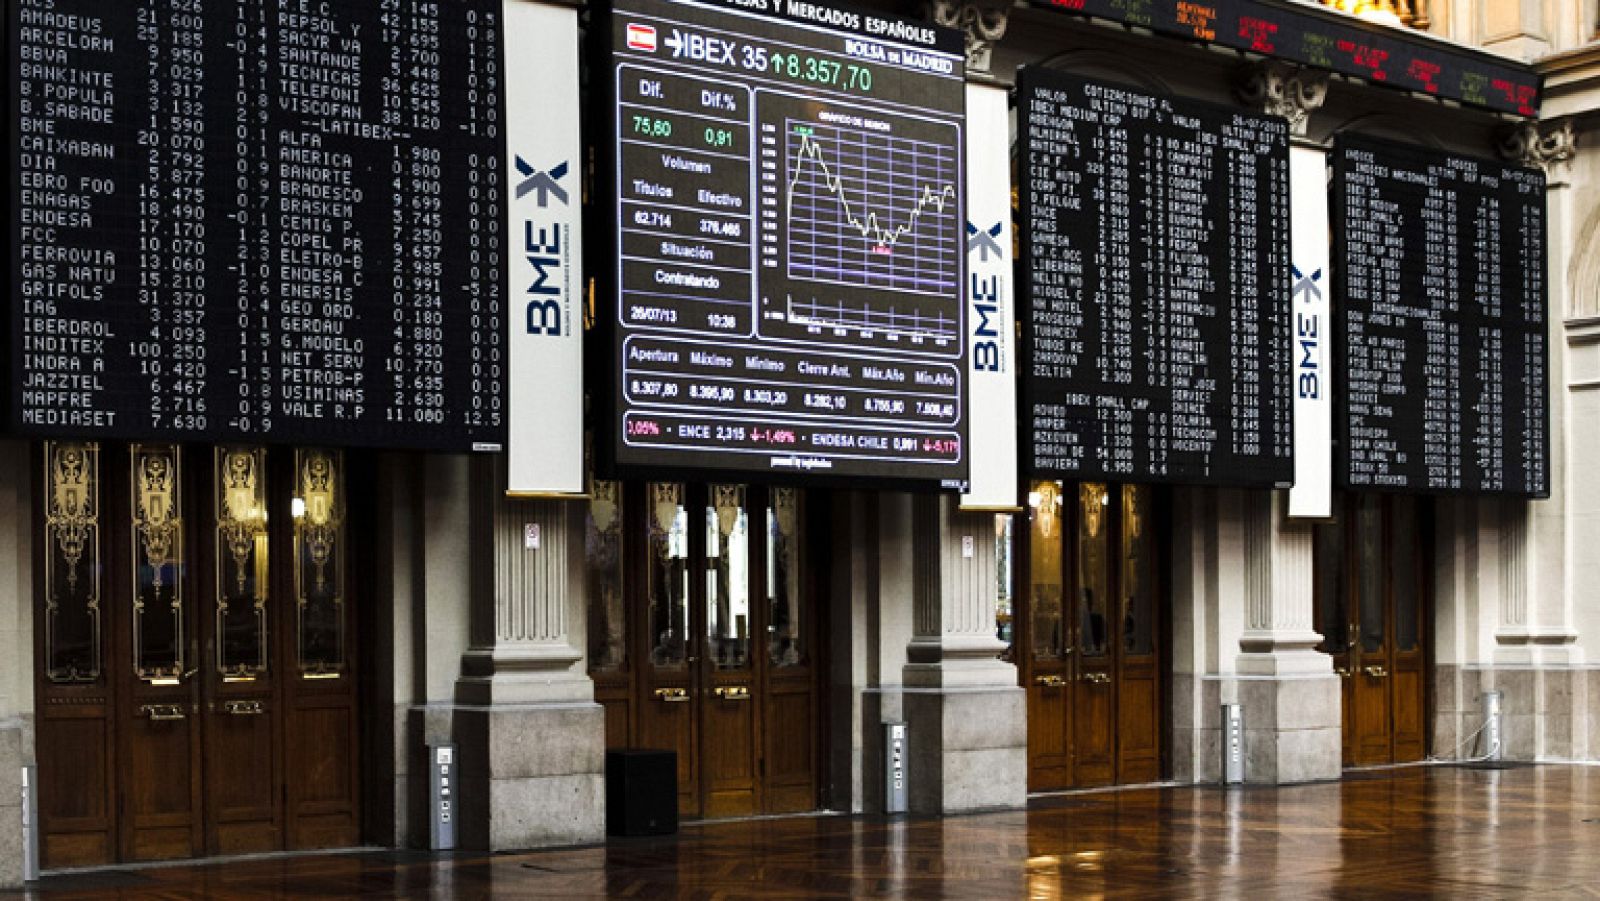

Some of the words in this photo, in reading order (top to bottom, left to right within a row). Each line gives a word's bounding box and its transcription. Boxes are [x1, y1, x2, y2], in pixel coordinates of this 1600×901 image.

[20, 8, 101, 33] AMADEUS
[137, 25, 203, 47] 25.185
[278, 13, 340, 34] REPSOL
[351, 23, 361, 37] Y
[773, 0, 782, 13] Y
[787, 4, 859, 29] MERCADOS
[865, 16, 936, 45] ESPAÑOLES
[20, 27, 113, 52] ARCELORM
[149, 45, 203, 63] 9.950
[278, 29, 330, 49] SACYR
[341, 38, 361, 53] VA
[20, 45, 67, 64] BBVA
[149, 62, 203, 81] 7.029
[279, 45, 361, 71] SANTANDE
[684, 32, 736, 66] IBEX
[742, 47, 767, 72] 35
[786, 55, 872, 91] 8.357,70
[845, 39, 886, 61] BOLSA
[901, 53, 953, 73] MADRID
[20, 62, 113, 88] BANKINTE
[149, 79, 203, 98] 3.317
[279, 62, 361, 87] TECNICAS
[20, 80, 113, 105] B.POPULA
[149, 97, 203, 116] 3.132
[279, 79, 360, 103] TELEFONI
[639, 79, 664, 99] Dif.
[701, 89, 736, 111] Dif.%
[20, 99, 113, 123] B.SABADE
[150, 115, 204, 134] 1.590
[278, 96, 361, 119] VISCOFAN
[20, 117, 55, 134] BME
[137, 131, 204, 151] 20.070
[279, 129, 322, 148] ALFA
[632, 116, 672, 137] 75,60
[704, 128, 733, 147] 0,91
[20, 135, 115, 158] CAIXABAN
[149, 150, 204, 168] 2.792
[280, 147, 352, 168] AMERICA
[661, 154, 712, 174] Volumen
[21, 154, 56, 171] DIA
[149, 167, 204, 185] 5.877
[280, 163, 352, 185] BANORTE
[21, 171, 67, 190] EBRO
[80, 177, 115, 194] FOO
[139, 183, 204, 203] 16.475
[280, 181, 363, 202] BRADESCO
[697, 189, 742, 207] Efectivo
[21, 190, 91, 209] ENAGAS
[139, 201, 204, 220] 18.490
[280, 198, 353, 218] BRASKEM
[21, 208, 92, 228] ENDESA
[139, 218, 204, 239] 17.170
[280, 214, 332, 232] CEMIG
[21, 226, 56, 243] FCC
[139, 236, 204, 255] 10.070
[280, 231, 331, 249] COPEL
[343, 236, 363, 252] PR
[660, 241, 713, 260] Situación
[21, 245, 115, 265] FERROVIA
[139, 254, 204, 272] 13.060
[280, 248, 363, 268] ELETRO-B
[22, 262, 56, 279] GAS
[69, 266, 115, 284] NATU
[140, 272, 204, 290] 15.210
[280, 266, 343, 284] ENDESA
[354, 271, 363, 286] C
[525, 219, 561, 336] BME
[655, 269, 720, 289] Contratando
[22, 281, 103, 301] GRIFOLS
[139, 290, 205, 307] 31.370
[281, 281, 353, 301] ENERSIS
[24, 299, 57, 315] IAG
[151, 308, 205, 325] 3.357
[281, 300, 313, 315] GEO
[24, 318, 115, 337] IBERDROL
[151, 326, 205, 343] 4.093
[281, 317, 343, 334] GERDAU
[972, 272, 999, 372] BME
[24, 335, 104, 353] INDITEX
[129, 342, 206, 360] 100.250
[281, 334, 363, 353] G.MODELO
[1298, 312, 1319, 400] BME
[24, 354, 80, 371] INDRA
[93, 357, 104, 371] A
[141, 360, 206, 378] 10.420
[281, 352, 312, 366] NET
[324, 353, 364, 368] SERV
[629, 346, 679, 365] Apertura
[689, 351, 734, 368] Máximo
[745, 355, 786, 372] Mínimo
[797, 361, 828, 376] Cierre
[23, 372, 103, 391] JAZZTEL
[151, 378, 206, 395] 6.467
[282, 369, 364, 385] PETROB-P
[23, 391, 92, 408] MAPFRE
[151, 395, 206, 412] 2.716
[282, 386, 364, 402] USIMINAS
[22, 409, 116, 426] MEDIASET
[151, 414, 207, 431] 7.630
[282, 403, 323, 418] VALE
[678, 424, 711, 439] ENCE
[811, 433, 854, 447] ENDESA
[858, 436, 888, 449] CHILE
